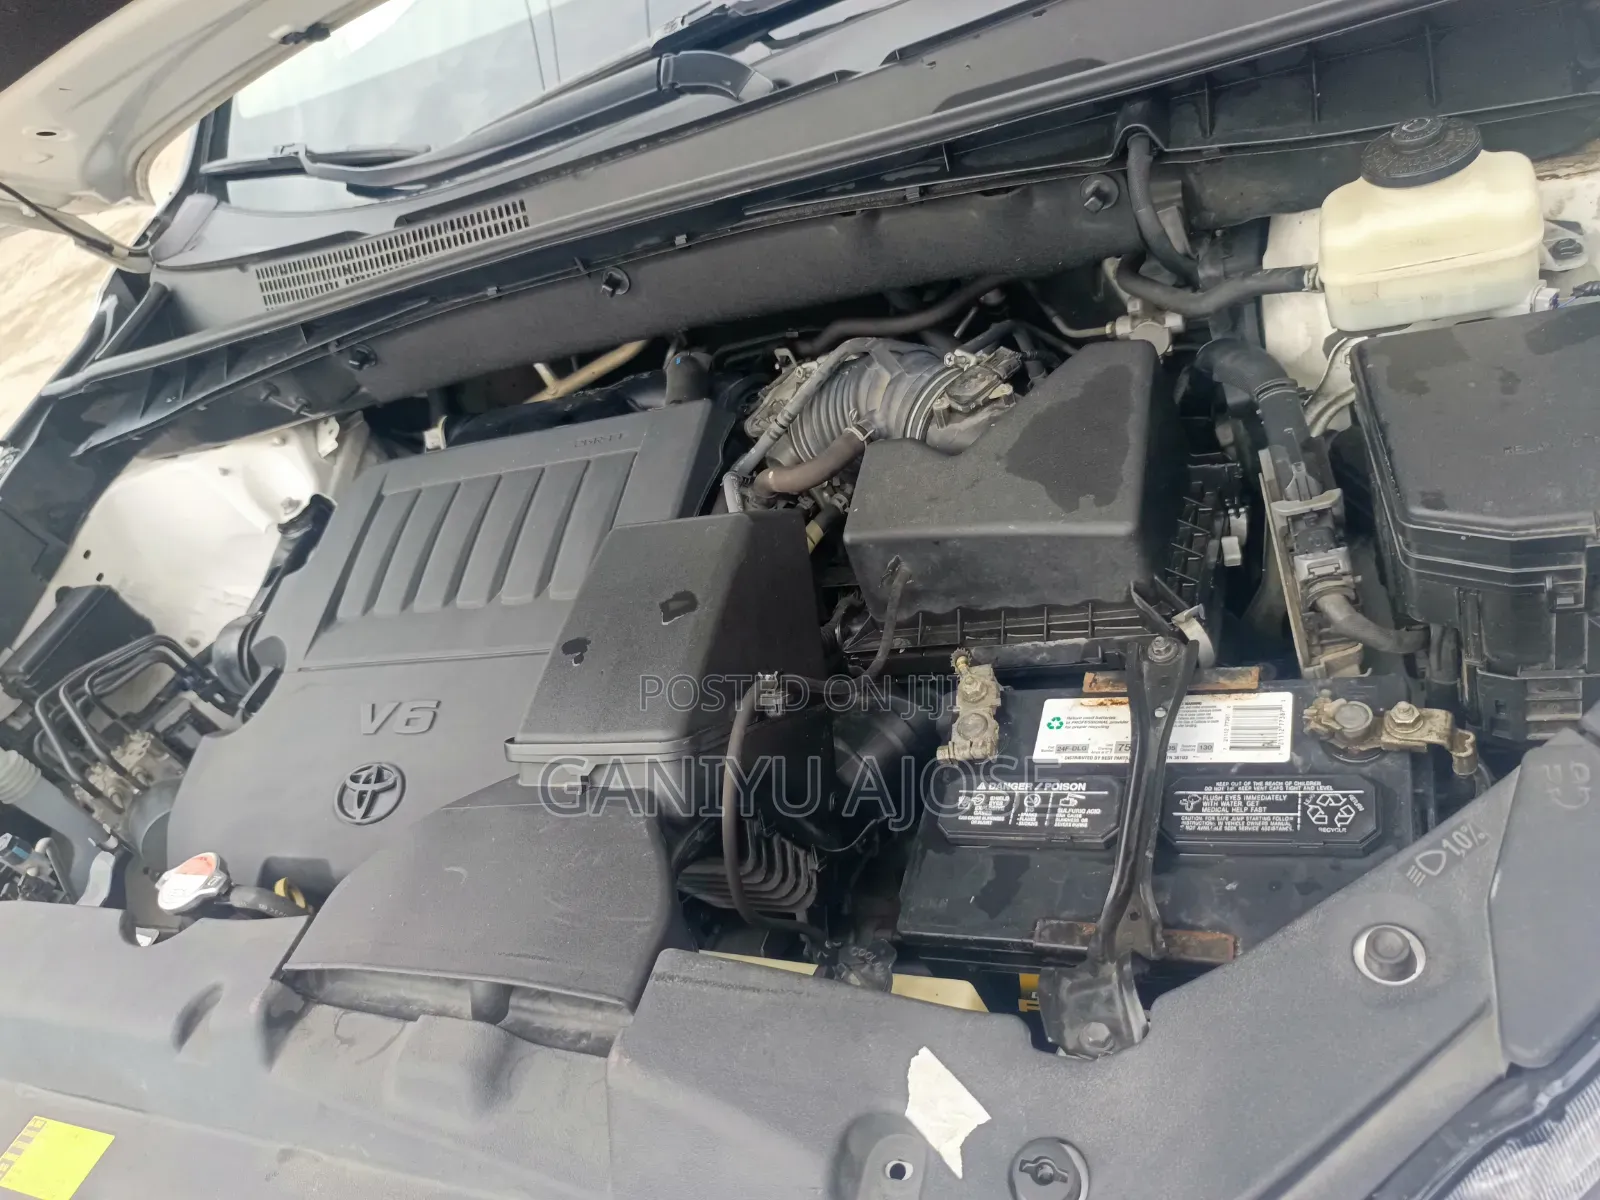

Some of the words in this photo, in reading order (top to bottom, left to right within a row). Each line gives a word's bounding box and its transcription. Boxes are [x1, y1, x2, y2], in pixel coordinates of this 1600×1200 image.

[361, 699, 441, 735] V6
[988, 782, 1033, 791] DANGER
[1044, 782, 1087, 791] POISON
